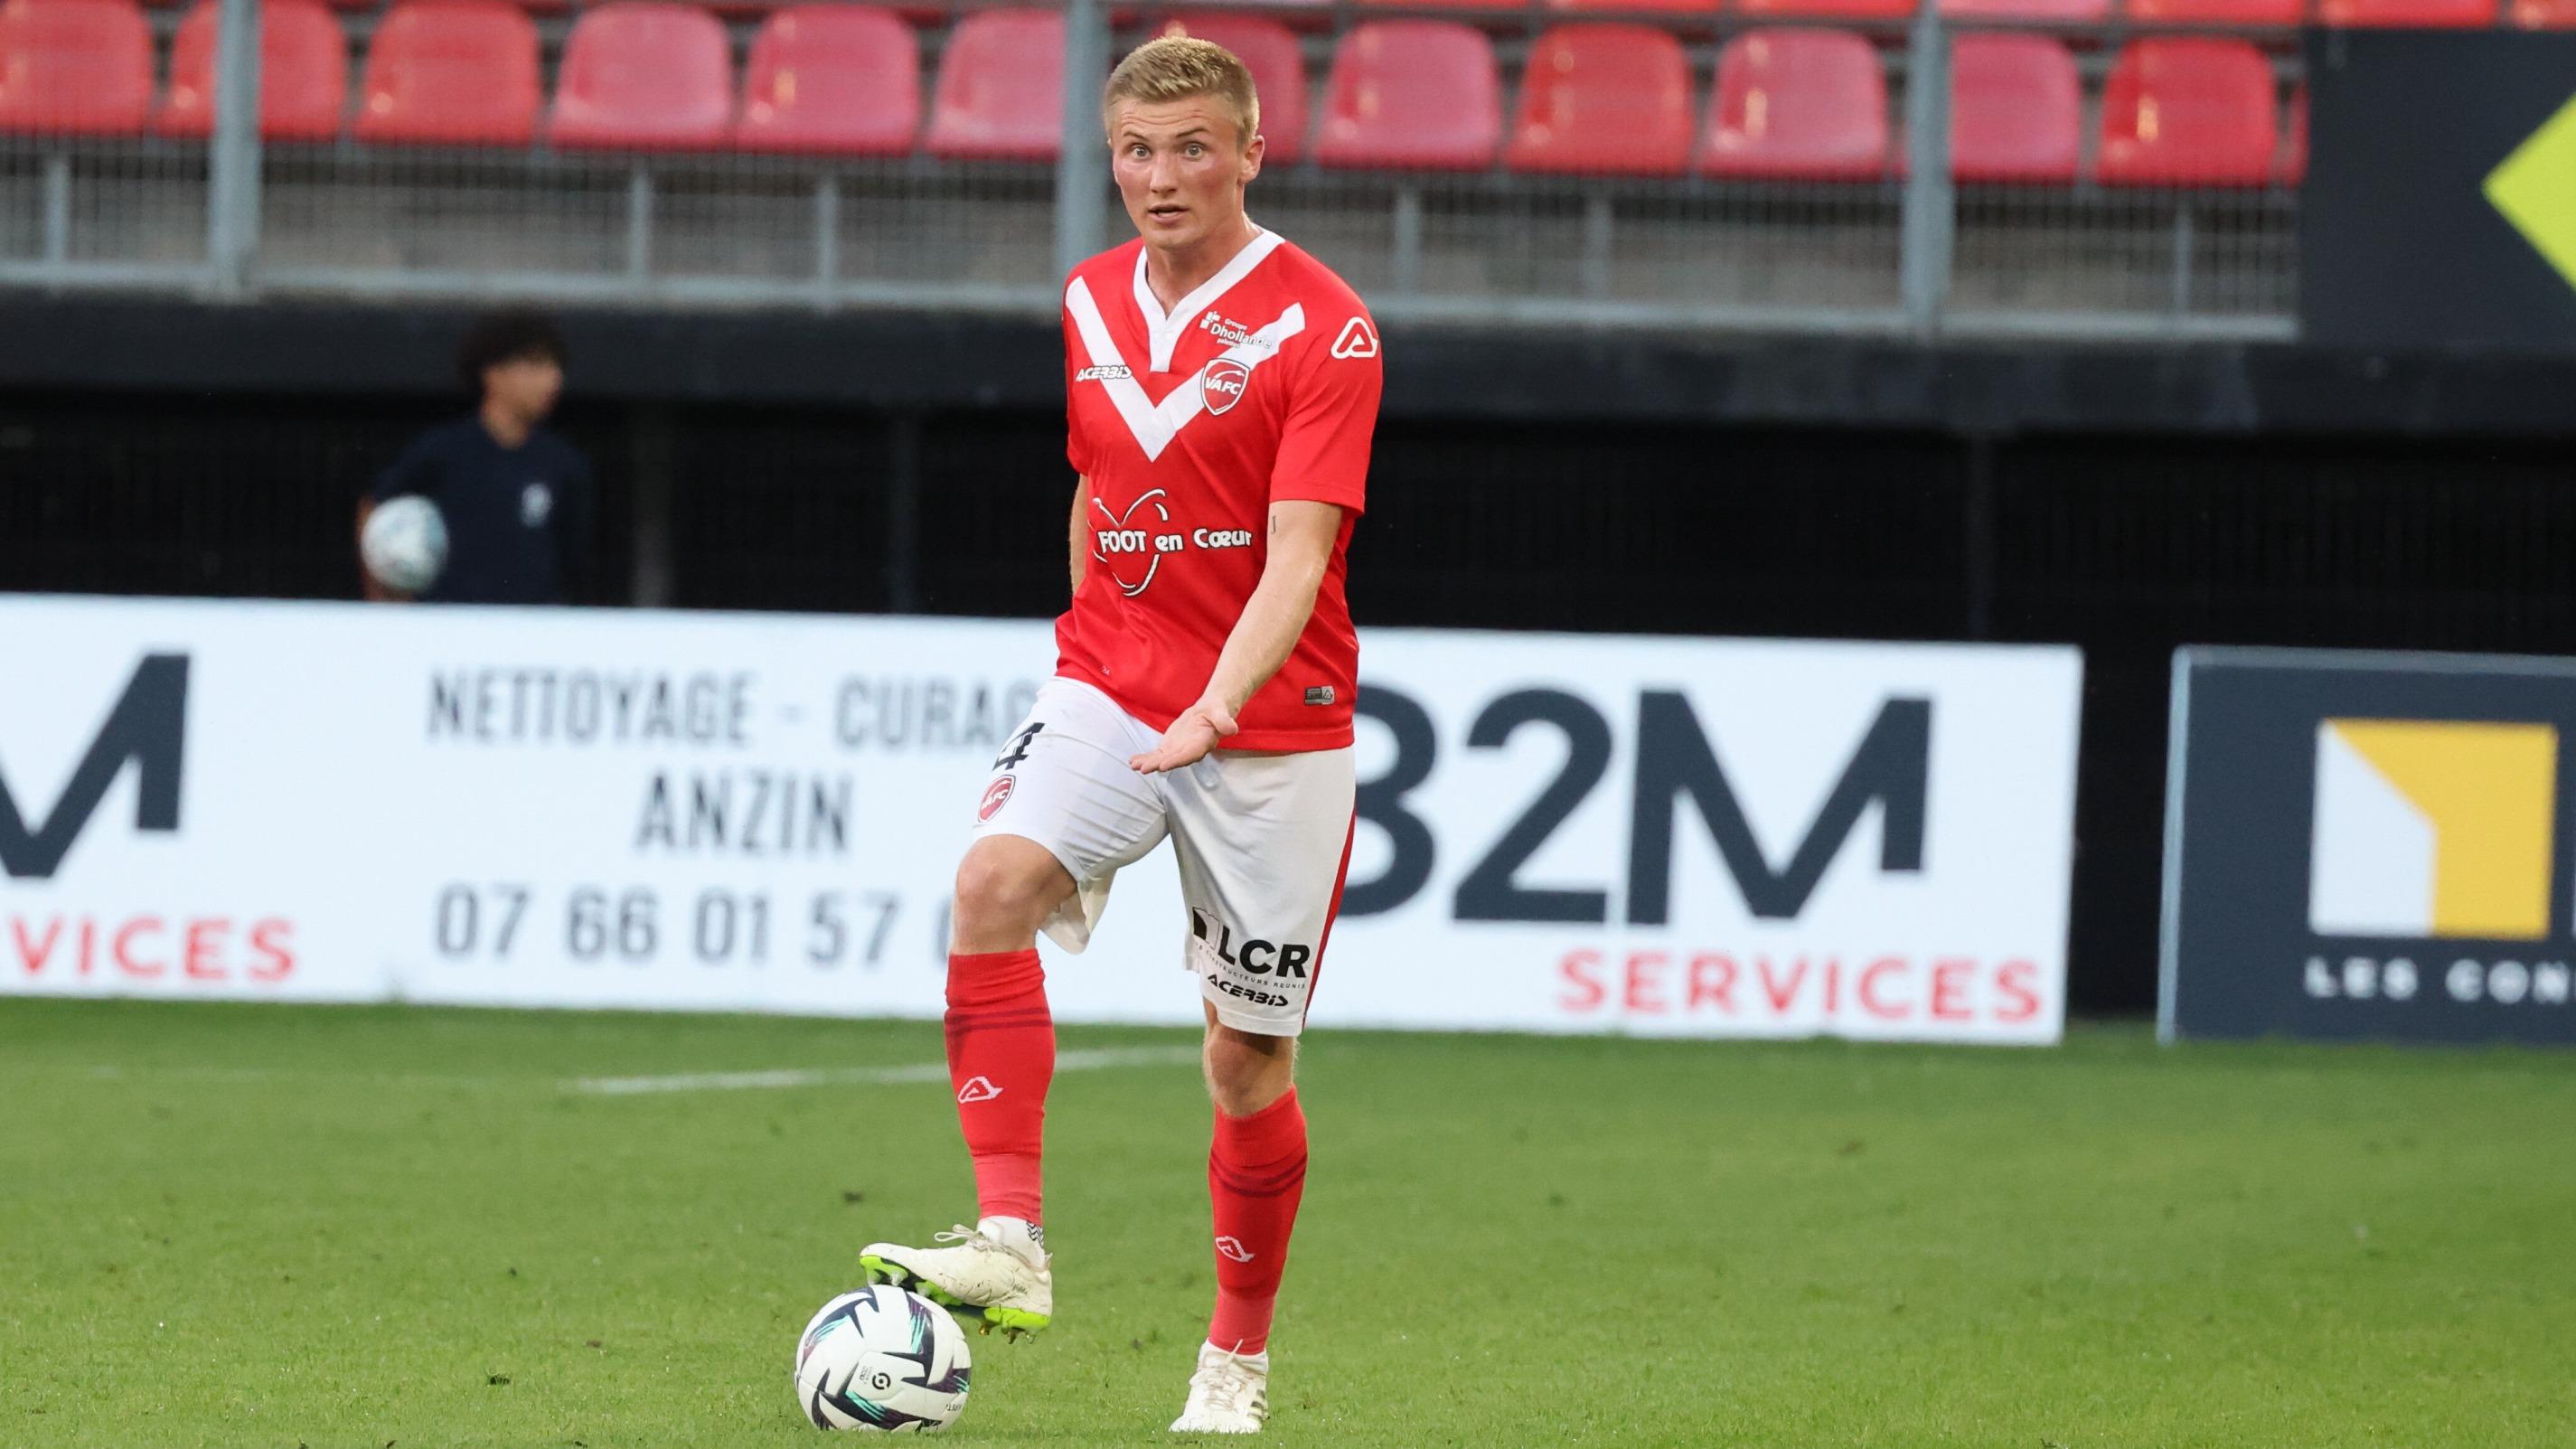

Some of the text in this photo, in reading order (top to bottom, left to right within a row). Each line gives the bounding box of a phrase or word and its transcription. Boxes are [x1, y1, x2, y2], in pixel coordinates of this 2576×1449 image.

[1205, 377, 1241, 395] VAFC
[1097, 530, 1147, 553] FOOT
[1154, 534, 1183, 551] en
[428, 668, 749, 745] NETTOYAGE
[992, 722, 1045, 770] 4
[636, 769, 851, 853] ANZIN
[435, 883, 531, 959] 07
[565, 889, 659, 963] 66
[691, 889, 771, 964] 01
[806, 891, 902, 969] 57
[1217, 925, 1311, 978] LCR
[1559, 950, 2042, 1024] SERVICES
[2304, 956, 2421, 1000] LES
